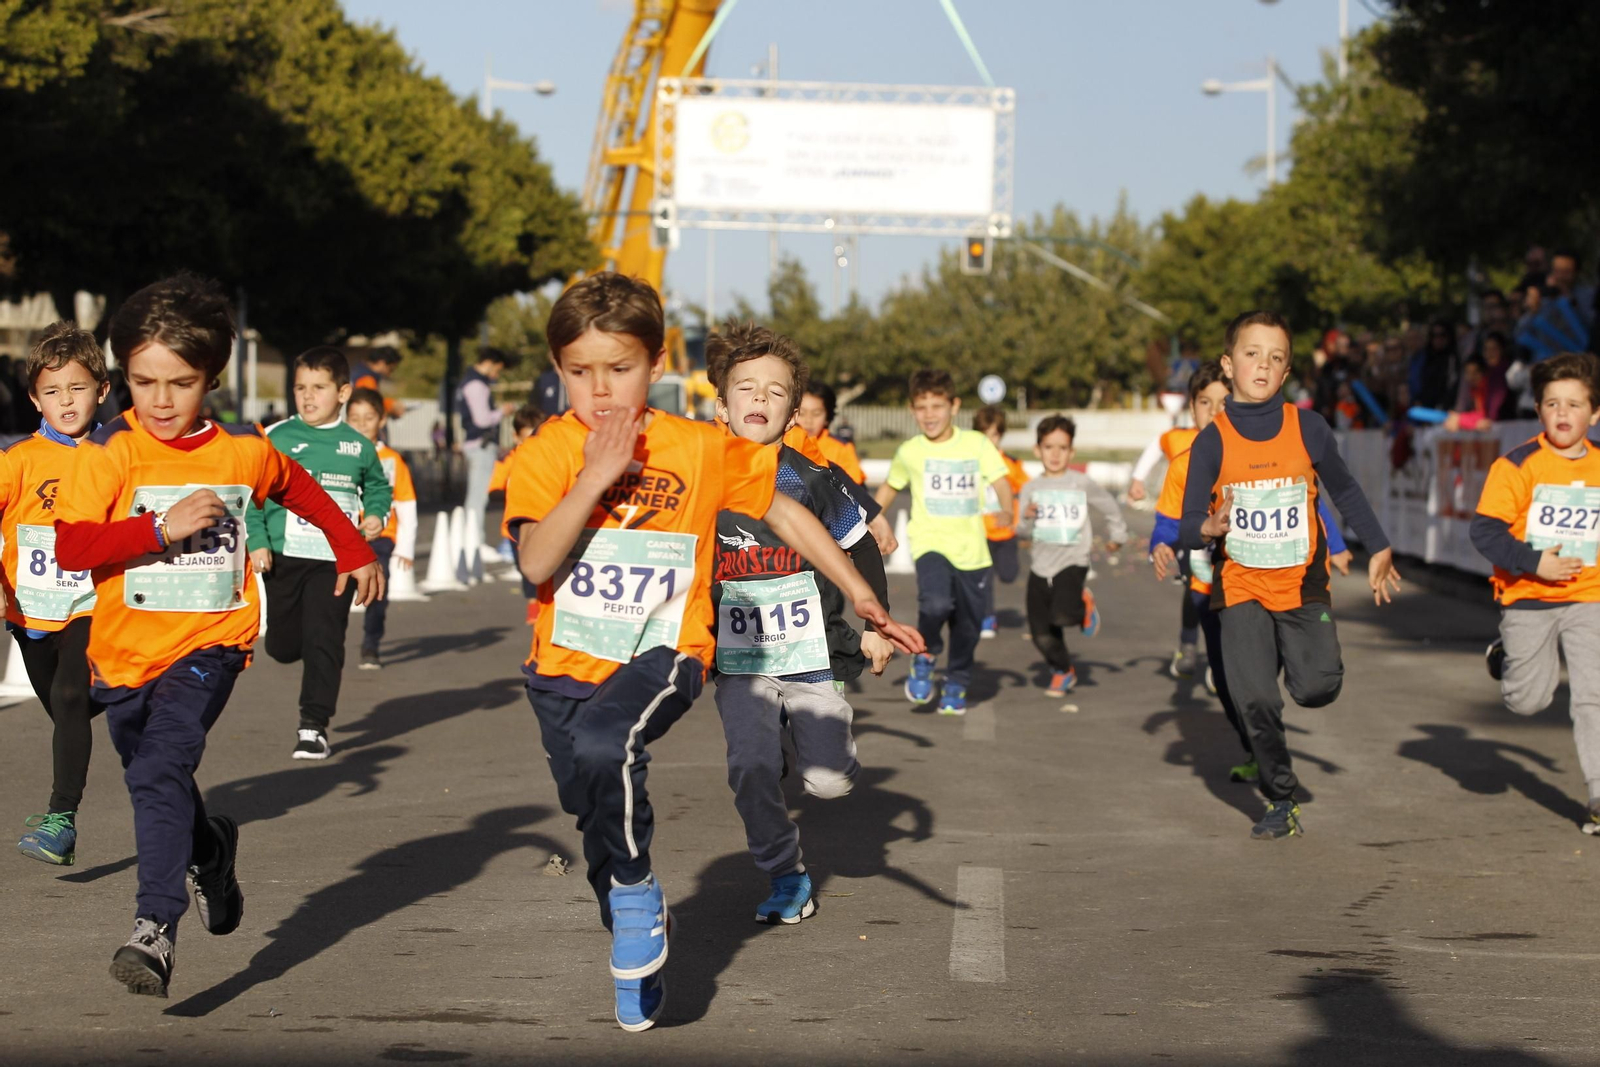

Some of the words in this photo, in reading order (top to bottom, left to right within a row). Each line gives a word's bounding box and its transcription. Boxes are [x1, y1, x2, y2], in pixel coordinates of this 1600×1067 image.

[614, 473, 671, 493] UPER
[602, 487, 679, 511] UNNER
[1235, 506, 1299, 532] 8018
[1539, 505, 1600, 530] 8227
[148, 518, 238, 555] 153
[1246, 531, 1267, 539] HUGO
[1269, 531, 1289, 539] CARA
[164, 556, 226, 566] ALEJANDRO
[56, 580, 79, 588] SERA
[570, 561, 676, 603] 8371
[777, 579, 807, 590] CARRERA
[779, 587, 811, 598] INFANTIL
[603, 602, 645, 615] PEPITO
[729, 598, 810, 635] 8115
[753, 633, 786, 643] SERGIO
